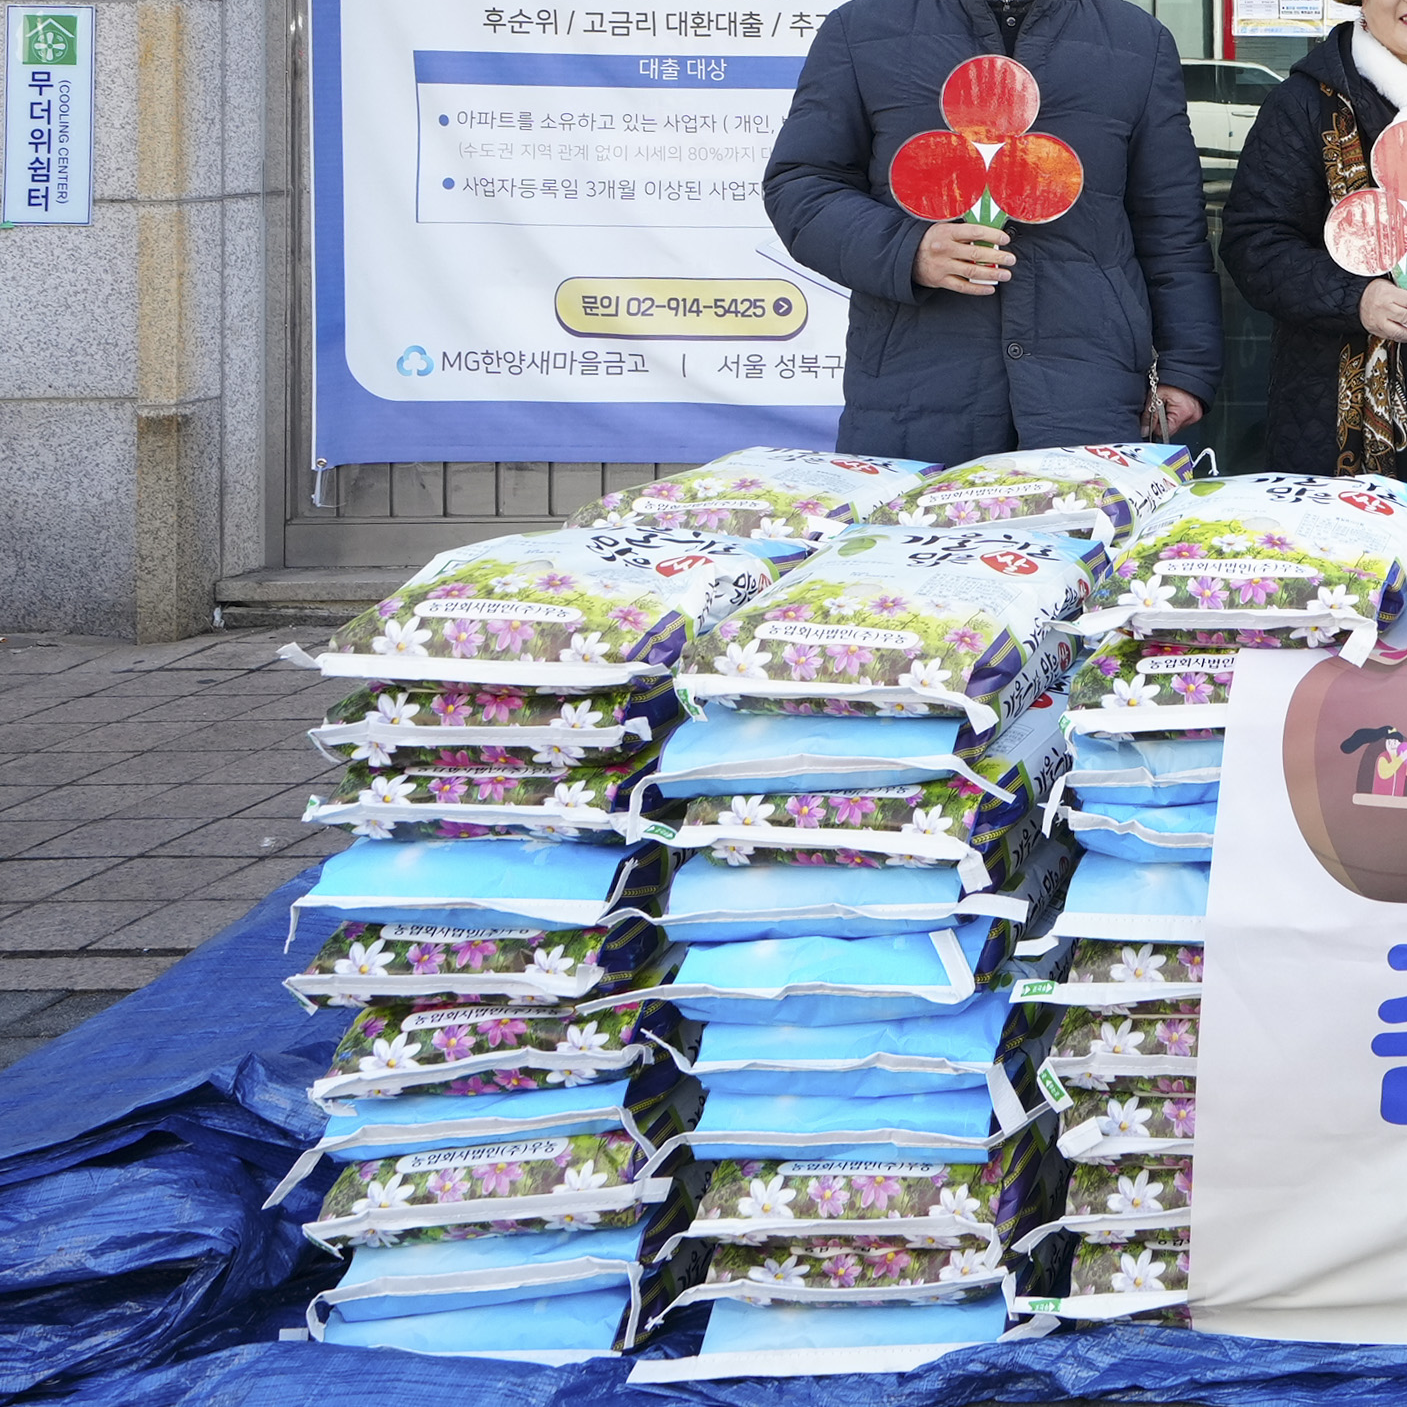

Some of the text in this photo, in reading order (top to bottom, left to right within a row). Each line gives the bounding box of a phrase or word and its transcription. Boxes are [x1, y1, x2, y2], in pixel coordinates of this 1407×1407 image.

[482, 6, 558, 37] 후순위
[583, 8, 657, 38] 고금리
[665, 10, 765, 39] 대환대출
[639, 58, 727, 82] 대출 대상
[457, 110, 774, 135] 아파트를 소유하고 있는 사업자 개인,
[28, 71, 54, 212] 무더위쉼터
[56, 80, 71, 205] (COOLING CENTER)
[459, 142, 755, 163] (수도권 지역 관계 없이 시세의 80%까지
[462, 177, 578, 200] 사업자등록일
[586, 179, 636, 201] 3개월
[644, 180, 702, 201] 이상된
[582, 295, 767, 318] 문의 02-914-5425
[442, 350, 844, 380] MG한양새마을금고 서울 성북구
[929, 482, 1044, 503] 농업회사법인(주)우농
[902, 531, 1061, 562] 가을하늘
[1167, 560, 1308, 576] 농업회사법인(주)우농
[428, 600, 568, 619] 농업회사법인(주)우농
[769, 624, 908, 645] 농업회사법인(주)우농
[1149, 656, 1236, 671] 농업회사법인
[411, 1140, 558, 1167] 농업회사법인(주)우농
